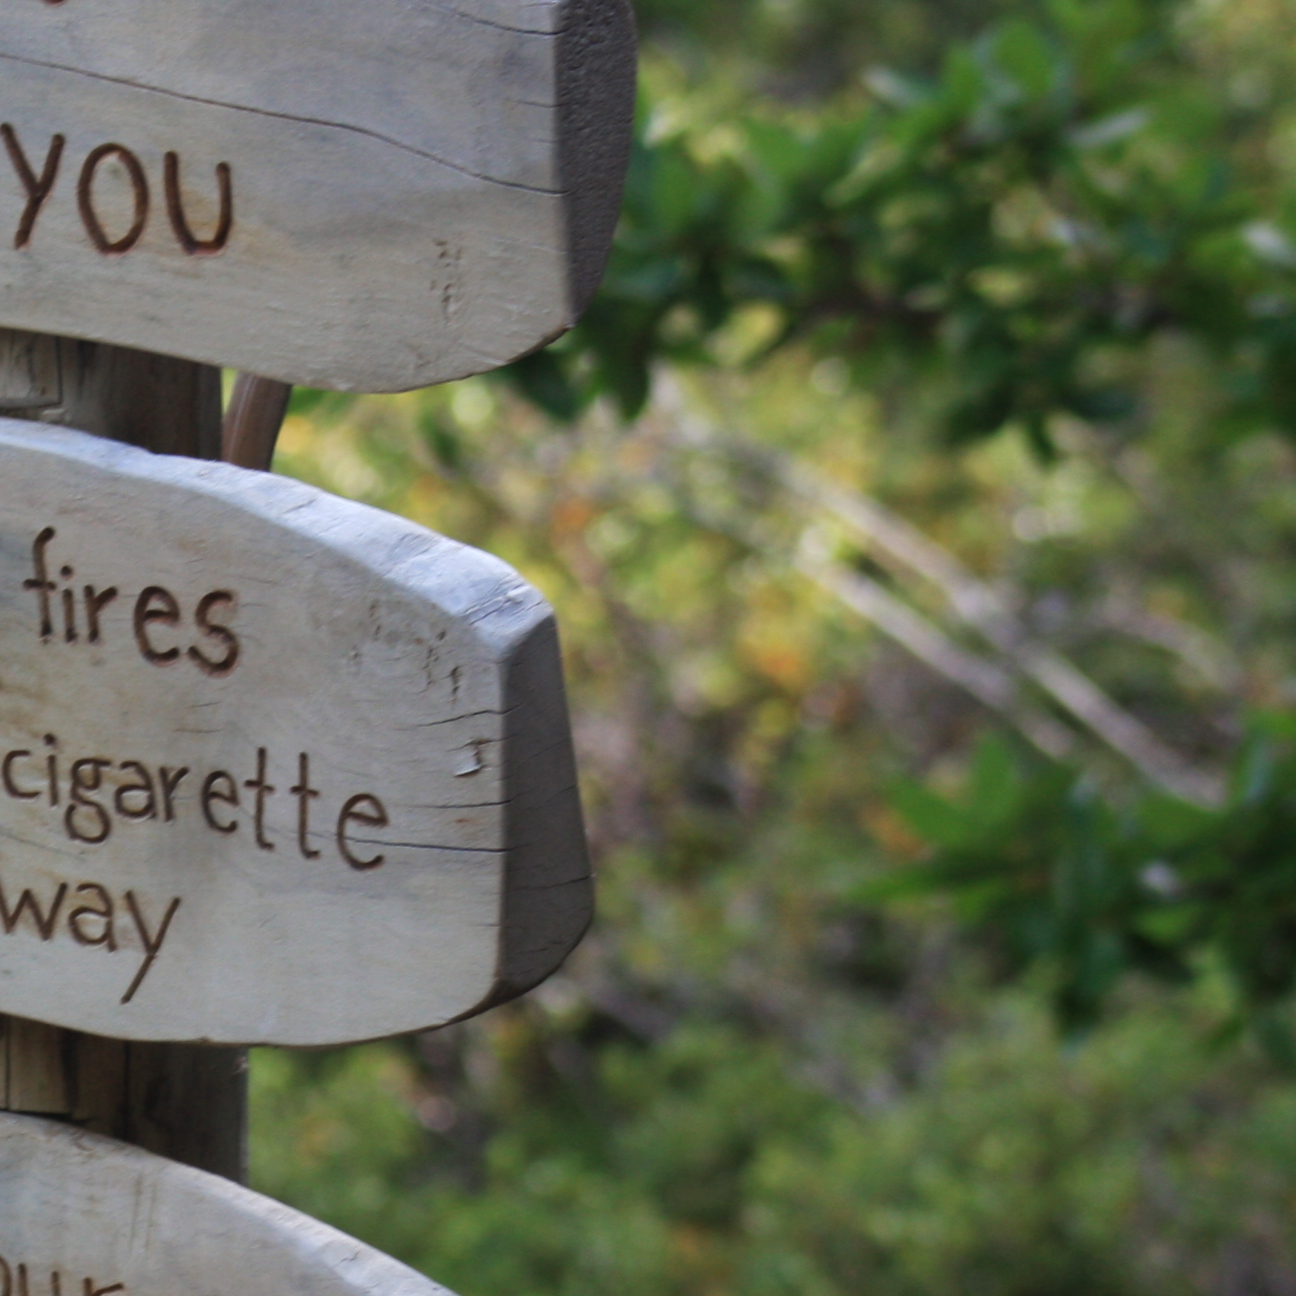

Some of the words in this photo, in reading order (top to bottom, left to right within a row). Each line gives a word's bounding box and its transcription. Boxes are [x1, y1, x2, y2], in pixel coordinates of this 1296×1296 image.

[0, 121, 234, 256] YOU
[23, 526, 240, 677] fires
[2, 734, 390, 872] cigarette
